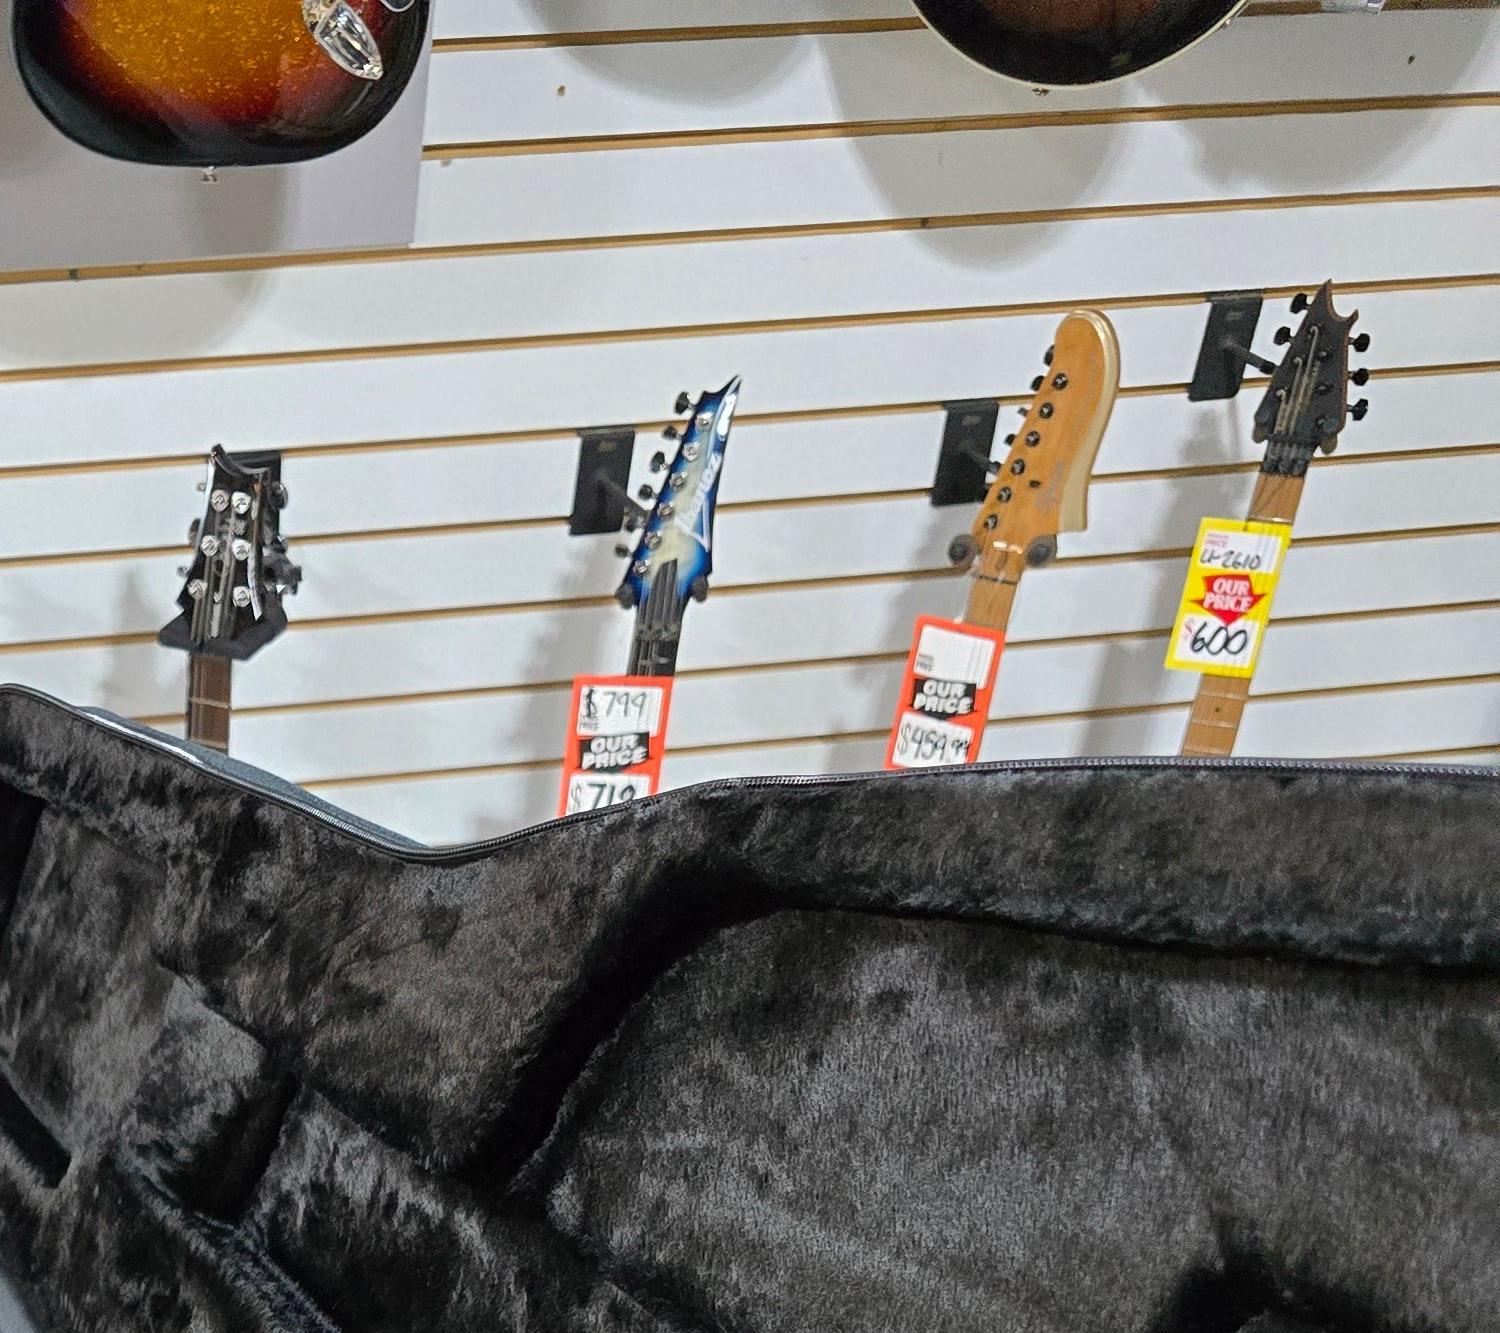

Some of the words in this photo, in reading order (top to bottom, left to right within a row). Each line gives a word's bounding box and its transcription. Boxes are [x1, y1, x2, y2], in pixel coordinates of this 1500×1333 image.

[1212, 576, 1250, 594] OUR
[1202, 592, 1255, 613] PRICE
[922, 678, 967, 699] OUR
[912, 692, 974, 716] PRICE
[590, 734, 639, 755] OUR
[581, 745, 649, 771] PRICE
